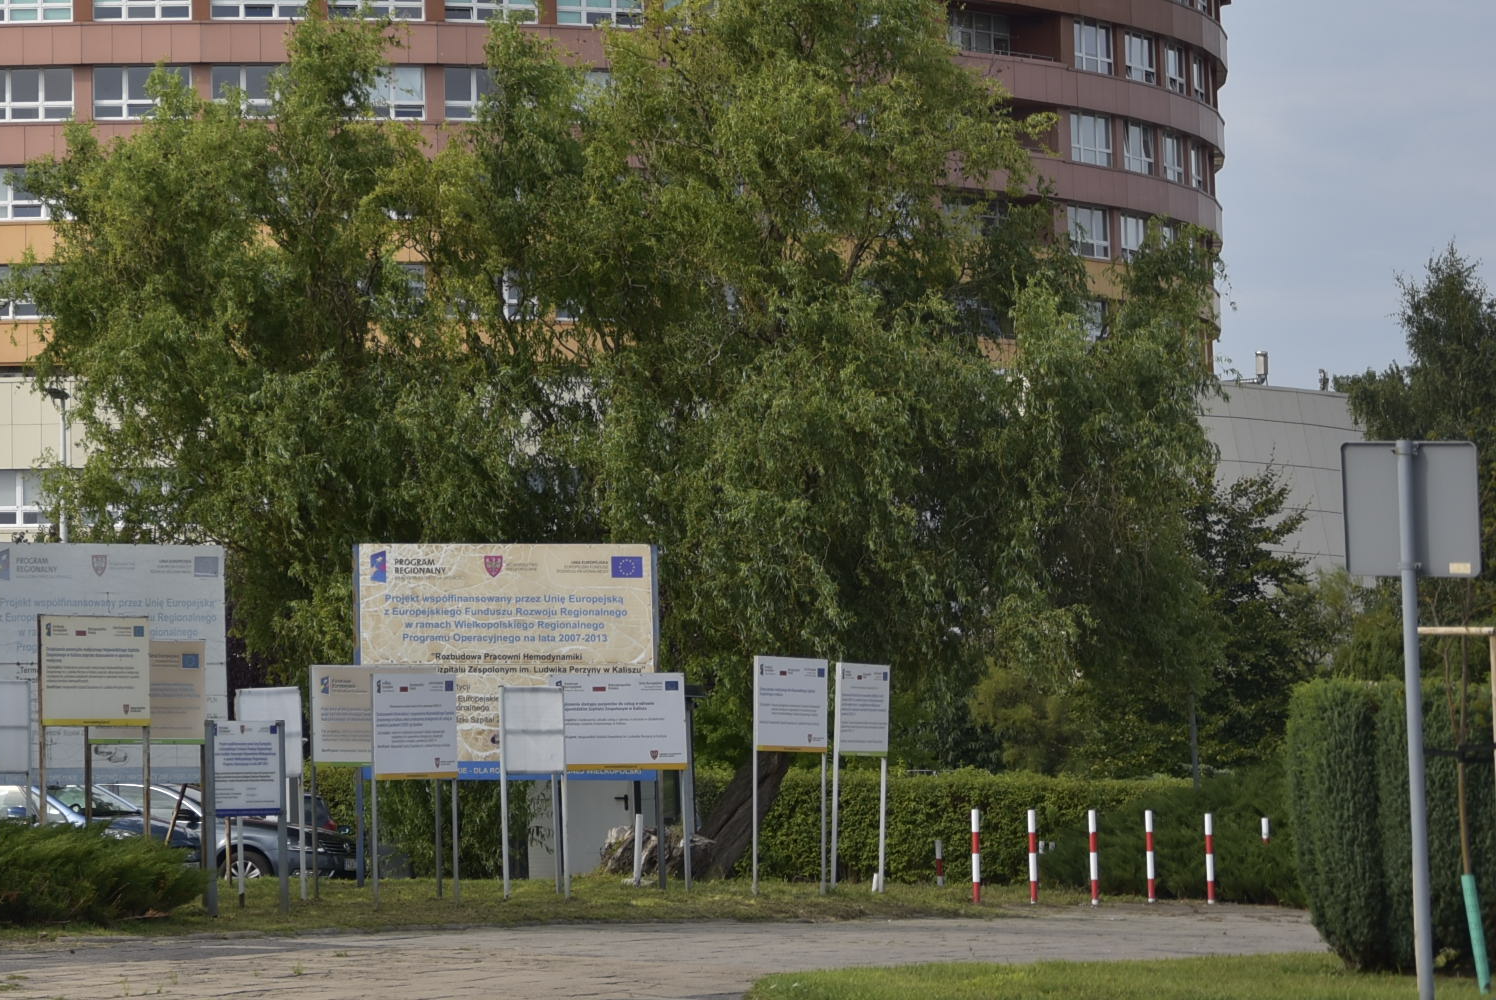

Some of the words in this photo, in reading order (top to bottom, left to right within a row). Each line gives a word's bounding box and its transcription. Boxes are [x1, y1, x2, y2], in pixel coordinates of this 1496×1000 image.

[15, 557, 49, 565] PROGRAM
[394, 558, 435, 566] PROGRAM
[15, 565, 57, 573] REGIONALNY
[394, 566, 446, 575] REGIONALNY
[0, 598, 31, 609] Projekt
[34, 599, 115, 610] współfinansowany
[118, 600, 142, 610] przez
[144, 599, 164, 610] Unię
[166, 599, 215, 610] Europejską
[384, 594, 420, 605] Projekt
[423, 594, 512, 605] współfinansowany
[515, 596, 541, 605] przez
[544, 594, 565, 605] Unię
[568, 594, 624, 605] Europejską
[392, 607, 461, 618] Europejskiego
[464, 607, 513, 616] Funduszu
[515, 607, 557, 618] Rozwoju
[560, 607, 627, 618] Regionalnego
[157, 613, 216, 624] Regionalnego
[415, 620, 451, 629] ramach
[454, 620, 534, 631] Wielkopolskiego
[537, 620, 605, 631] Regionalnego
[402, 633, 450, 643] Programu
[453, 633, 522, 644] Operacyjnego
[538, 633, 556, 642] lata
[559, 633, 608, 642] 2007-2013
[17, 642, 37, 654] Prog
[431, 652, 481, 661] "Rozbudowa
[483, 652, 521, 661] Pracowni
[523, 652, 583, 662] Hemodynamiki
[468, 666, 517, 675] Zespolonym
[534, 666, 567, 674] Ludwika
[569, 666, 601, 674] Perzyny
[612, 666, 645, 674] Kaliszu"
[457, 695, 499, 703] Europejskie
